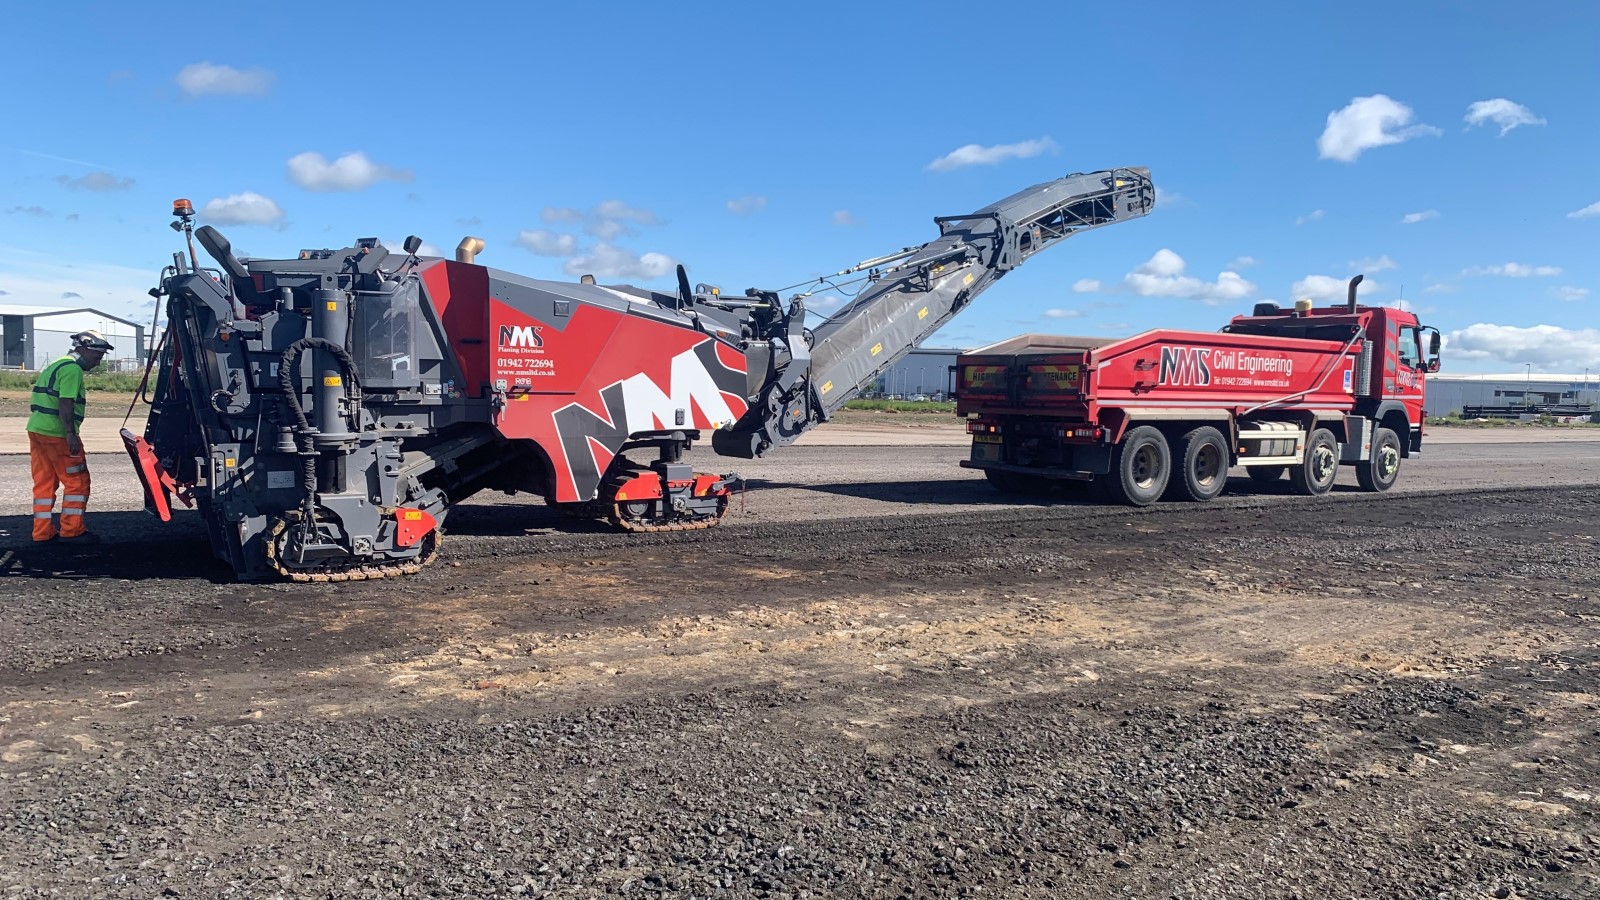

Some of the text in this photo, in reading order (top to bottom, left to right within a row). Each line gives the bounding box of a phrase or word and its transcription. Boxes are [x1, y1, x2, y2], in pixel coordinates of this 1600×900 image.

[498, 325, 544, 347] NMS
[497, 358, 554, 369] 01942 722694
[1159, 346, 1212, 386] NMS
[1213, 350, 1293, 377] Civil Engineering
[1221, 376, 1236, 386] 01942
[1236, 377, 1252, 386] 722694
